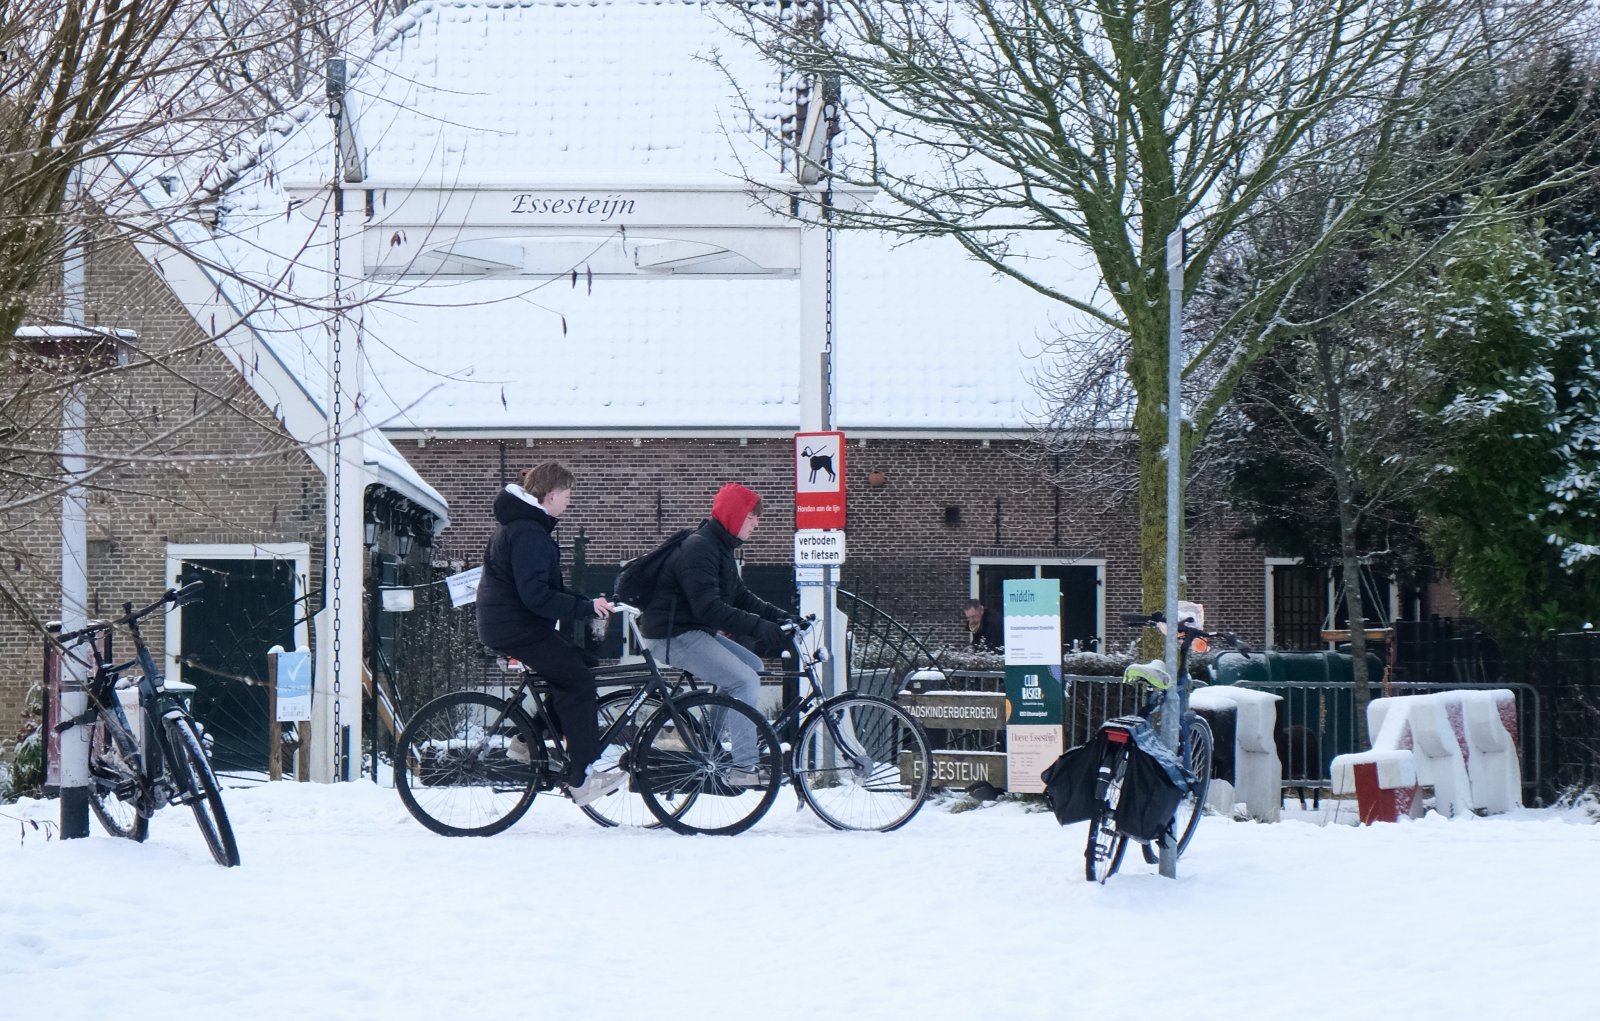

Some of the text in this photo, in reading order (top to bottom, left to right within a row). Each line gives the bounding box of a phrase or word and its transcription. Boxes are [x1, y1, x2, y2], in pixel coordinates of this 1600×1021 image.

[511, 194, 636, 222] Essesteijn
[797, 505, 815, 513] Honden
[799, 536, 836, 546] verboden
[801, 550, 840, 560] te fietsen
[1009, 590, 1035, 602] middin
[913, 761, 990, 782] ESESTEIJN
